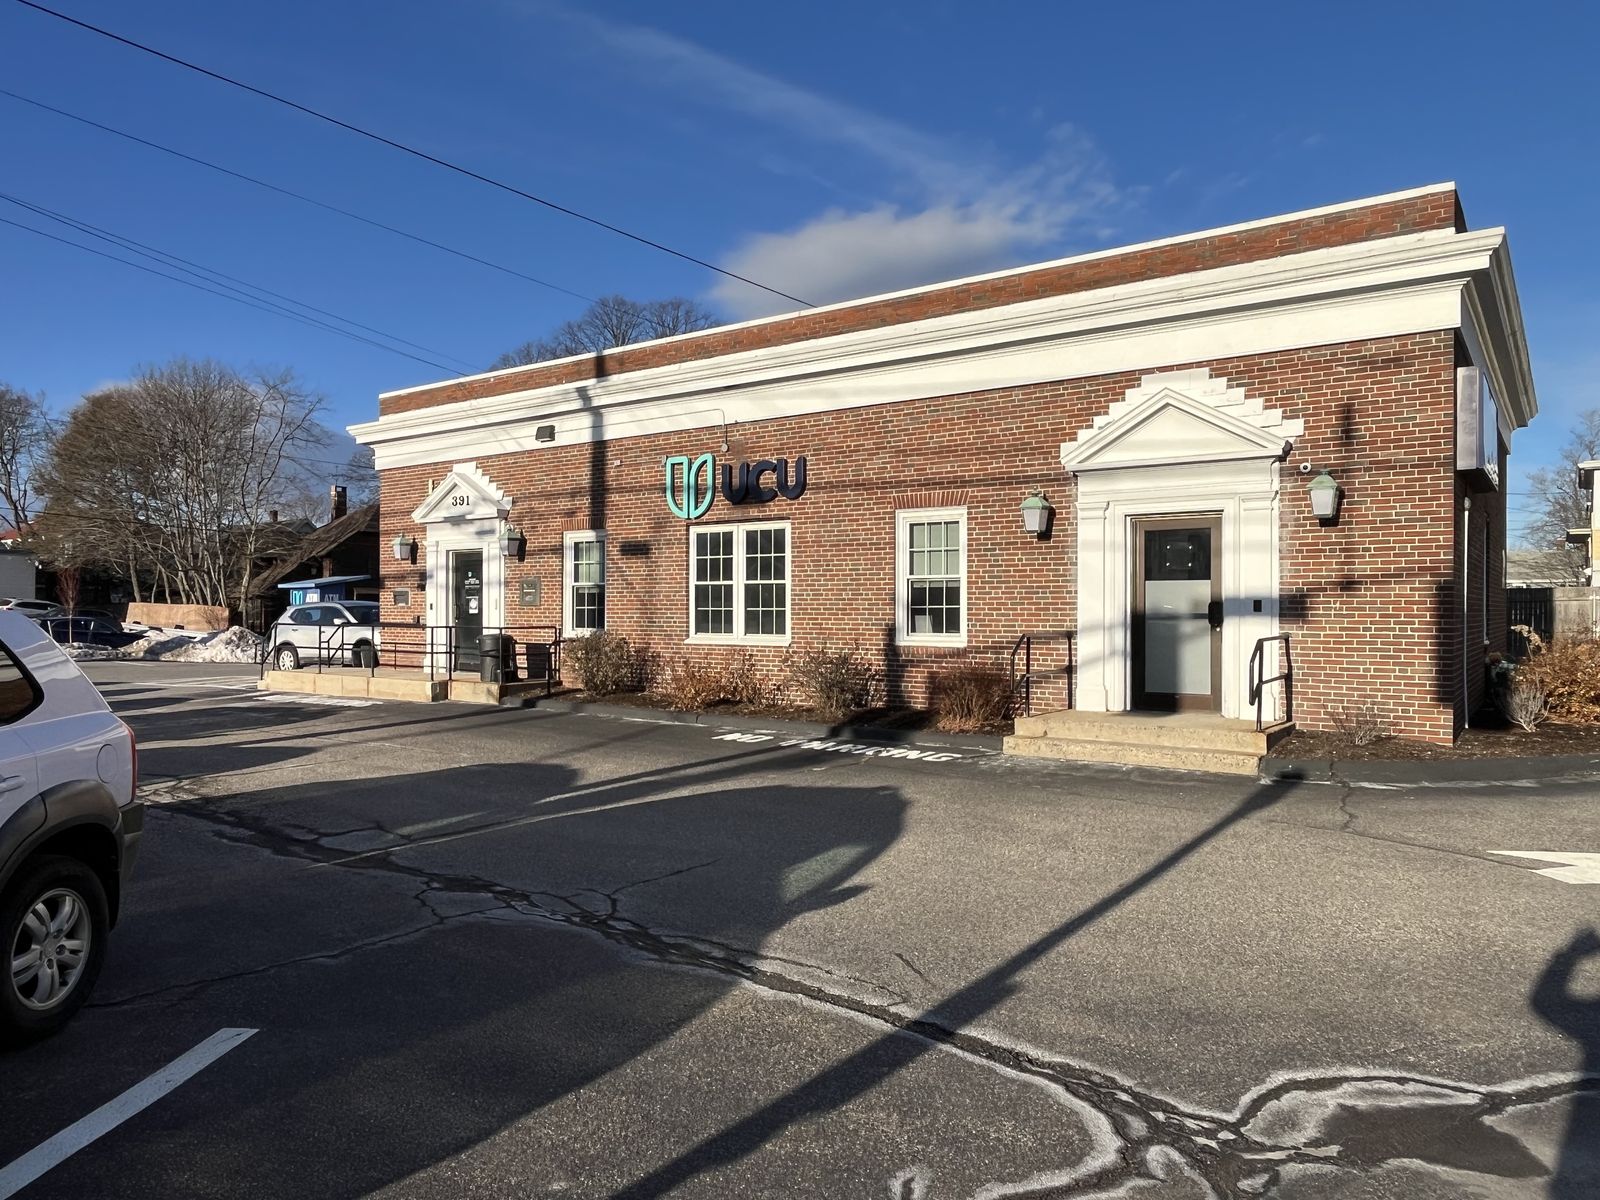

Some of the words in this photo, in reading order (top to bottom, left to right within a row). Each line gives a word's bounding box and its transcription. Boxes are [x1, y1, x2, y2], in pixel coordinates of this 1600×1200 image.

[722, 455, 807, 505] UCU
[452, 495, 470, 506] 391
[711, 732, 774, 743] NO
